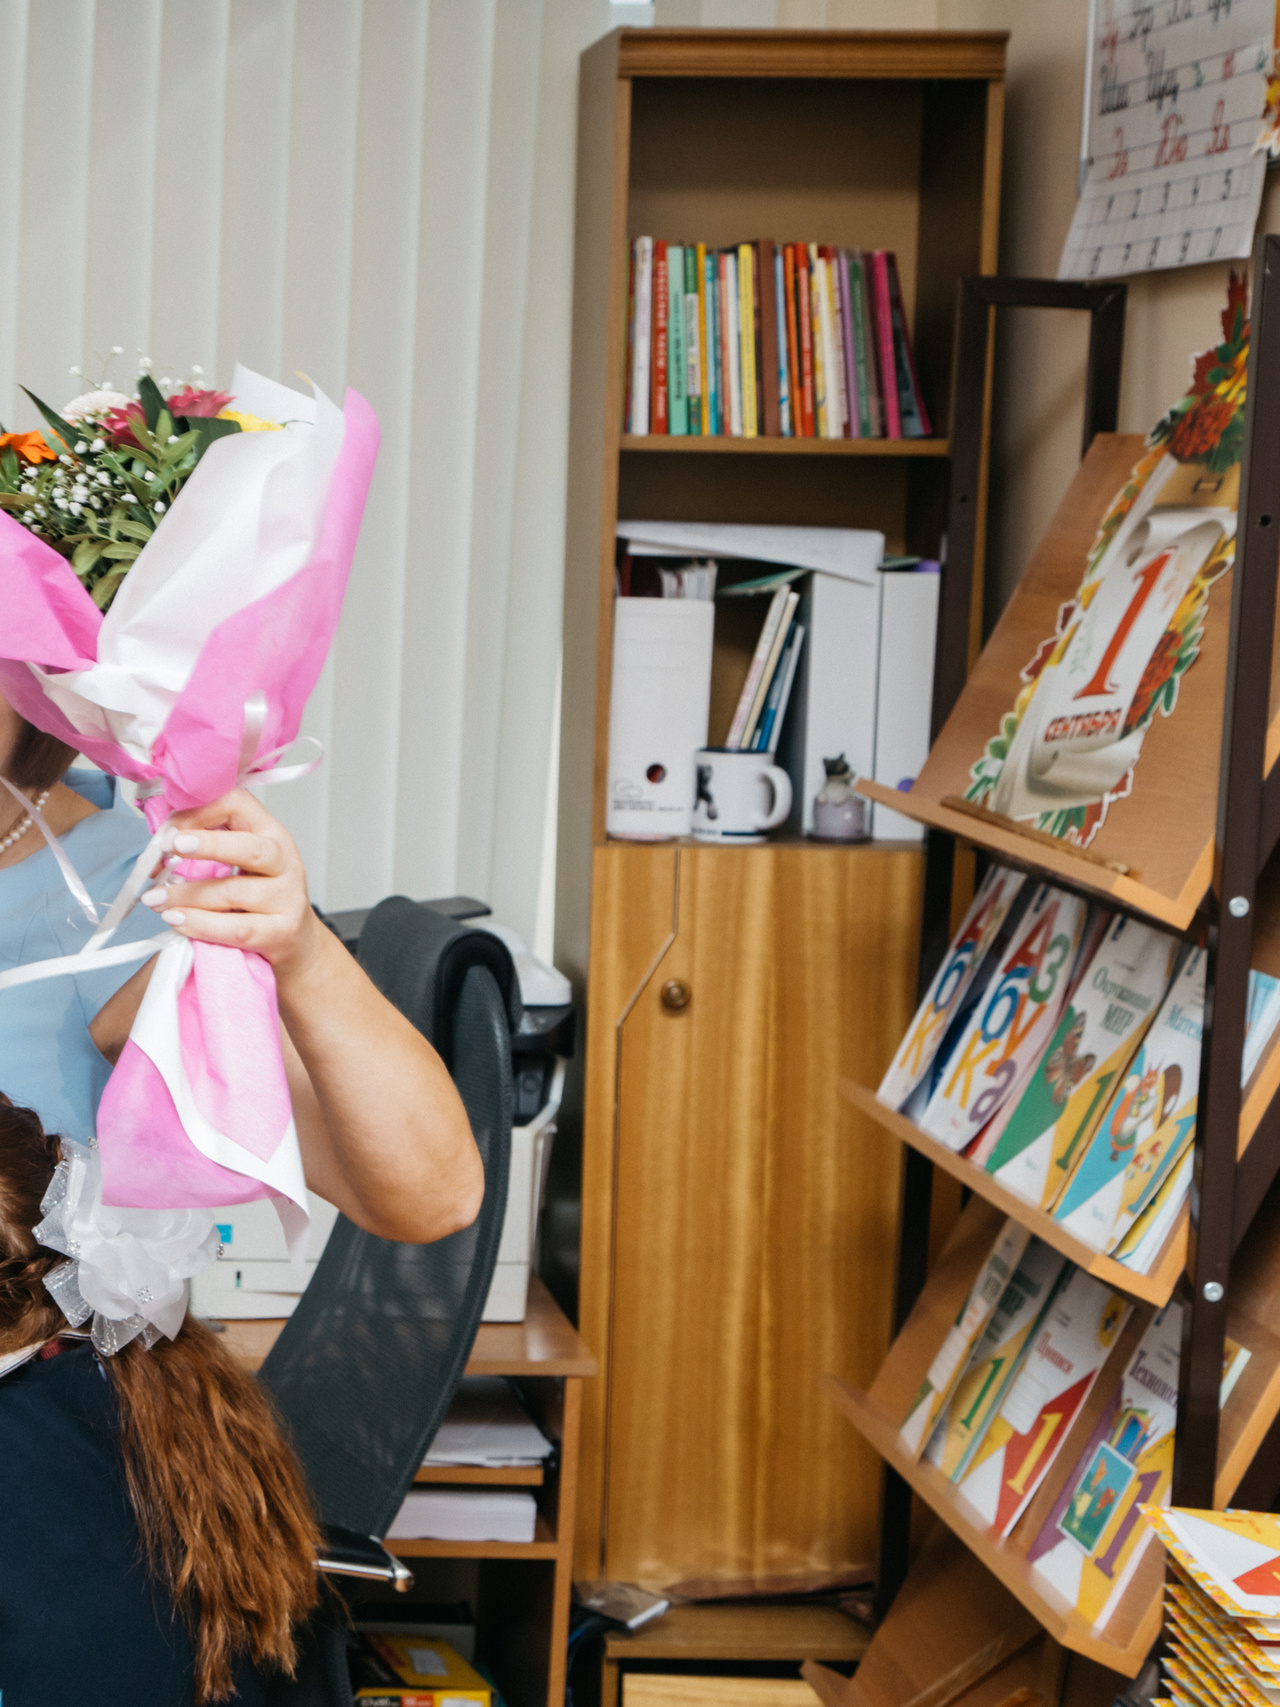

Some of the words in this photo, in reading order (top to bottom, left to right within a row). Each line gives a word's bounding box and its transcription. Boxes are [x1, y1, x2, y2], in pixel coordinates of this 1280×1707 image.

[1221, 167, 1234, 201] 5
[1072, 545, 1179, 701] 1
[1043, 707, 1122, 743] СЕНТЯБРЯ
[1055, 1069, 1119, 1173] 1
[1127, 1112, 1197, 1217] 1
[960, 1357, 1005, 1431] 1
[1006, 1412, 1064, 1496] 1
[1094, 1470, 1161, 1580] 1
